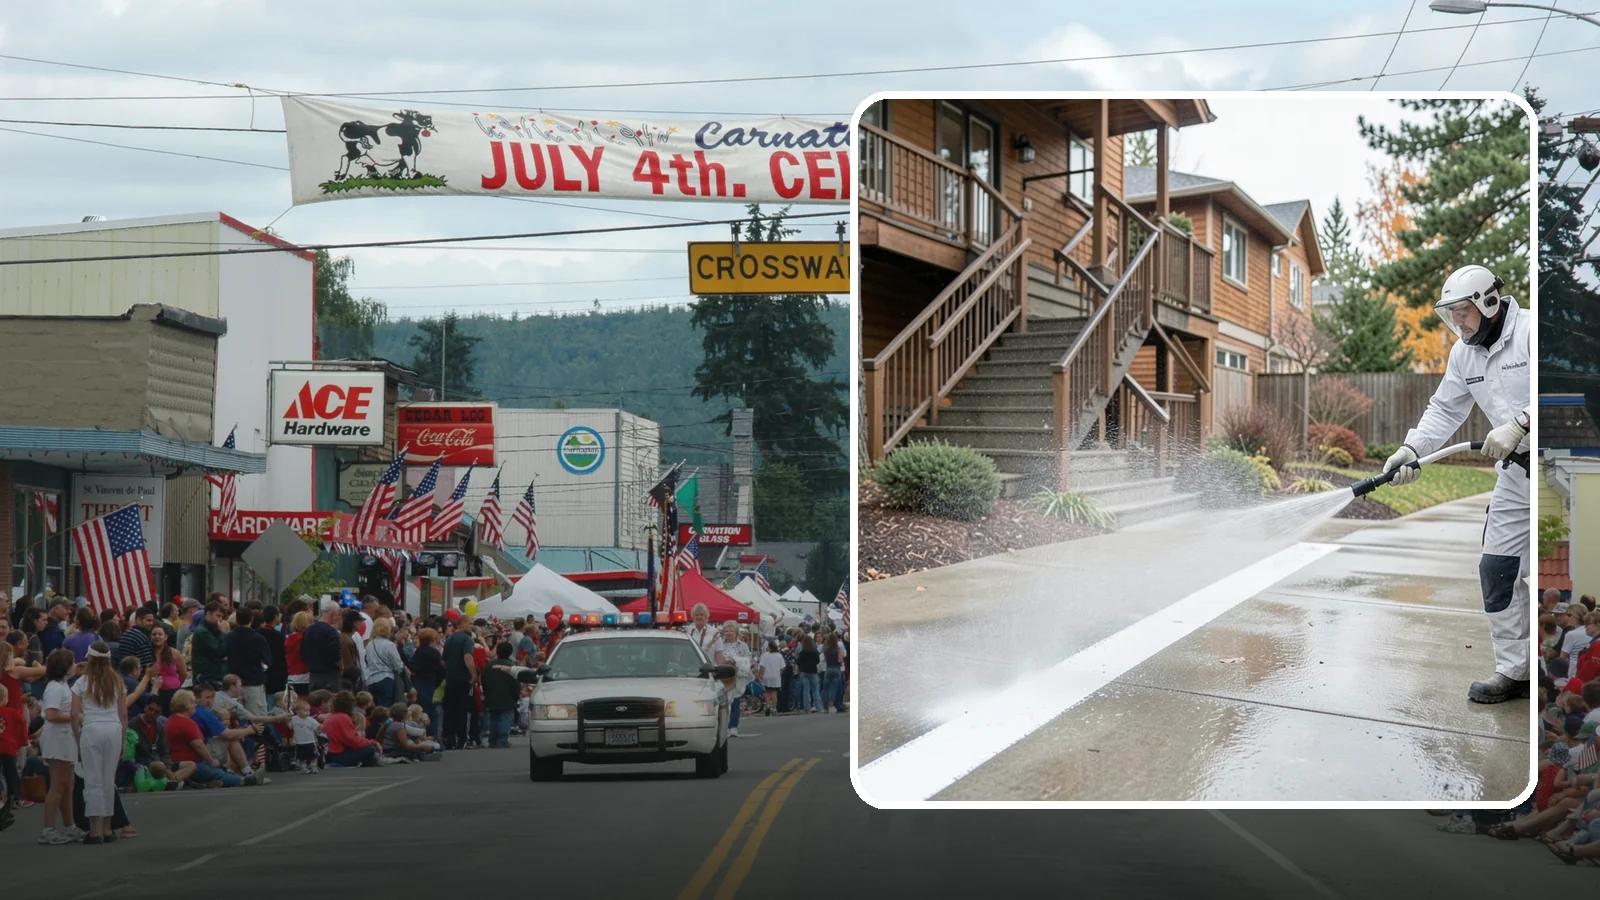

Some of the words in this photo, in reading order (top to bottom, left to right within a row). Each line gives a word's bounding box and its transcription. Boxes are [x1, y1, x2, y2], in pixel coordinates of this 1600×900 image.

[695, 121, 850, 150] Carnat
[481, 141, 604, 192] JULY
[632, 150, 746, 197] 4th.
[697, 254, 850, 280] CROSSWA
[283, 380, 373, 420] ACE
[405, 410, 452, 422] CEDAR
[461, 410, 485, 422] LOG
[283, 421, 371, 437] Hardware
[416, 428, 476, 446] Coca-Cola
[354, 468, 384, 482] Simpl
[84, 486, 94, 494] St.
[96, 485, 123, 495] Vincent
[126, 486, 136, 495] de
[138, 486, 155, 495] Paul
[81, 503, 154, 521] THT
[688, 527, 741, 535] CRNATION
[699, 535, 730, 543] GLASS
